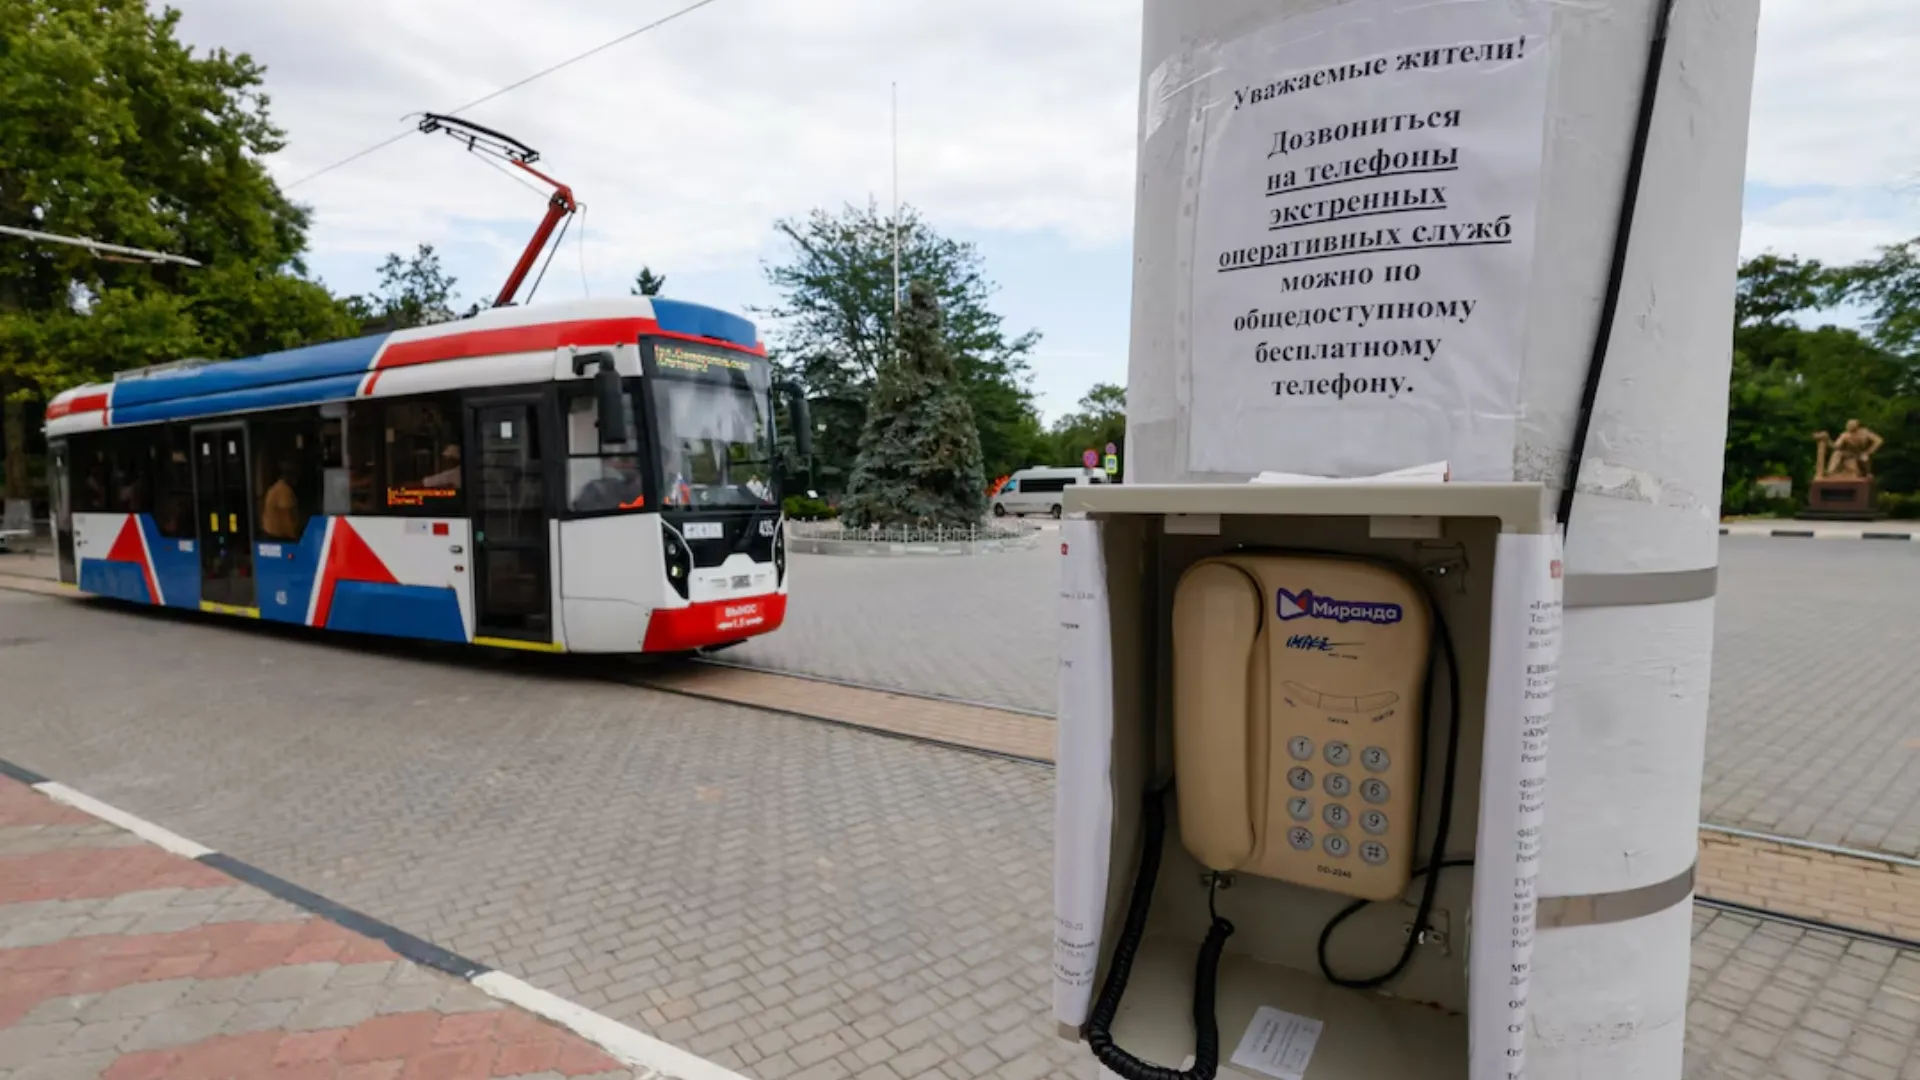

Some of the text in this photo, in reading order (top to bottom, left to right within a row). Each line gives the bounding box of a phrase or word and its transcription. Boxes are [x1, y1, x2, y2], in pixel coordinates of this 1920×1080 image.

[1233, 36, 1527, 110] Уважаемые жители!
[1267, 109, 1462, 157] Дозвониться
[1266, 147, 1458, 191] на телефоны
[1269, 186, 1447, 226] экстренных
[1219, 215, 1512, 269] оперативных служб
[1281, 263, 1422, 293] можно по
[1233, 299, 1477, 332] общедоступному
[1255, 337, 1442, 364] бесплатному
[1272, 374, 1414, 399] телефону.
[1312, 601, 1398, 621] Миранда
[1332, 746, 1343, 759] 2
[1370, 751, 1381, 764] 3
[1297, 771, 1306, 782] 4
[1332, 776, 1343, 790] 5
[1370, 783, 1381, 796] 6
[1296, 798, 1306, 812] 7
[1332, 807, 1342, 820] 8
[1369, 814, 1380, 827] 9
[1331, 838, 1341, 851] 0
